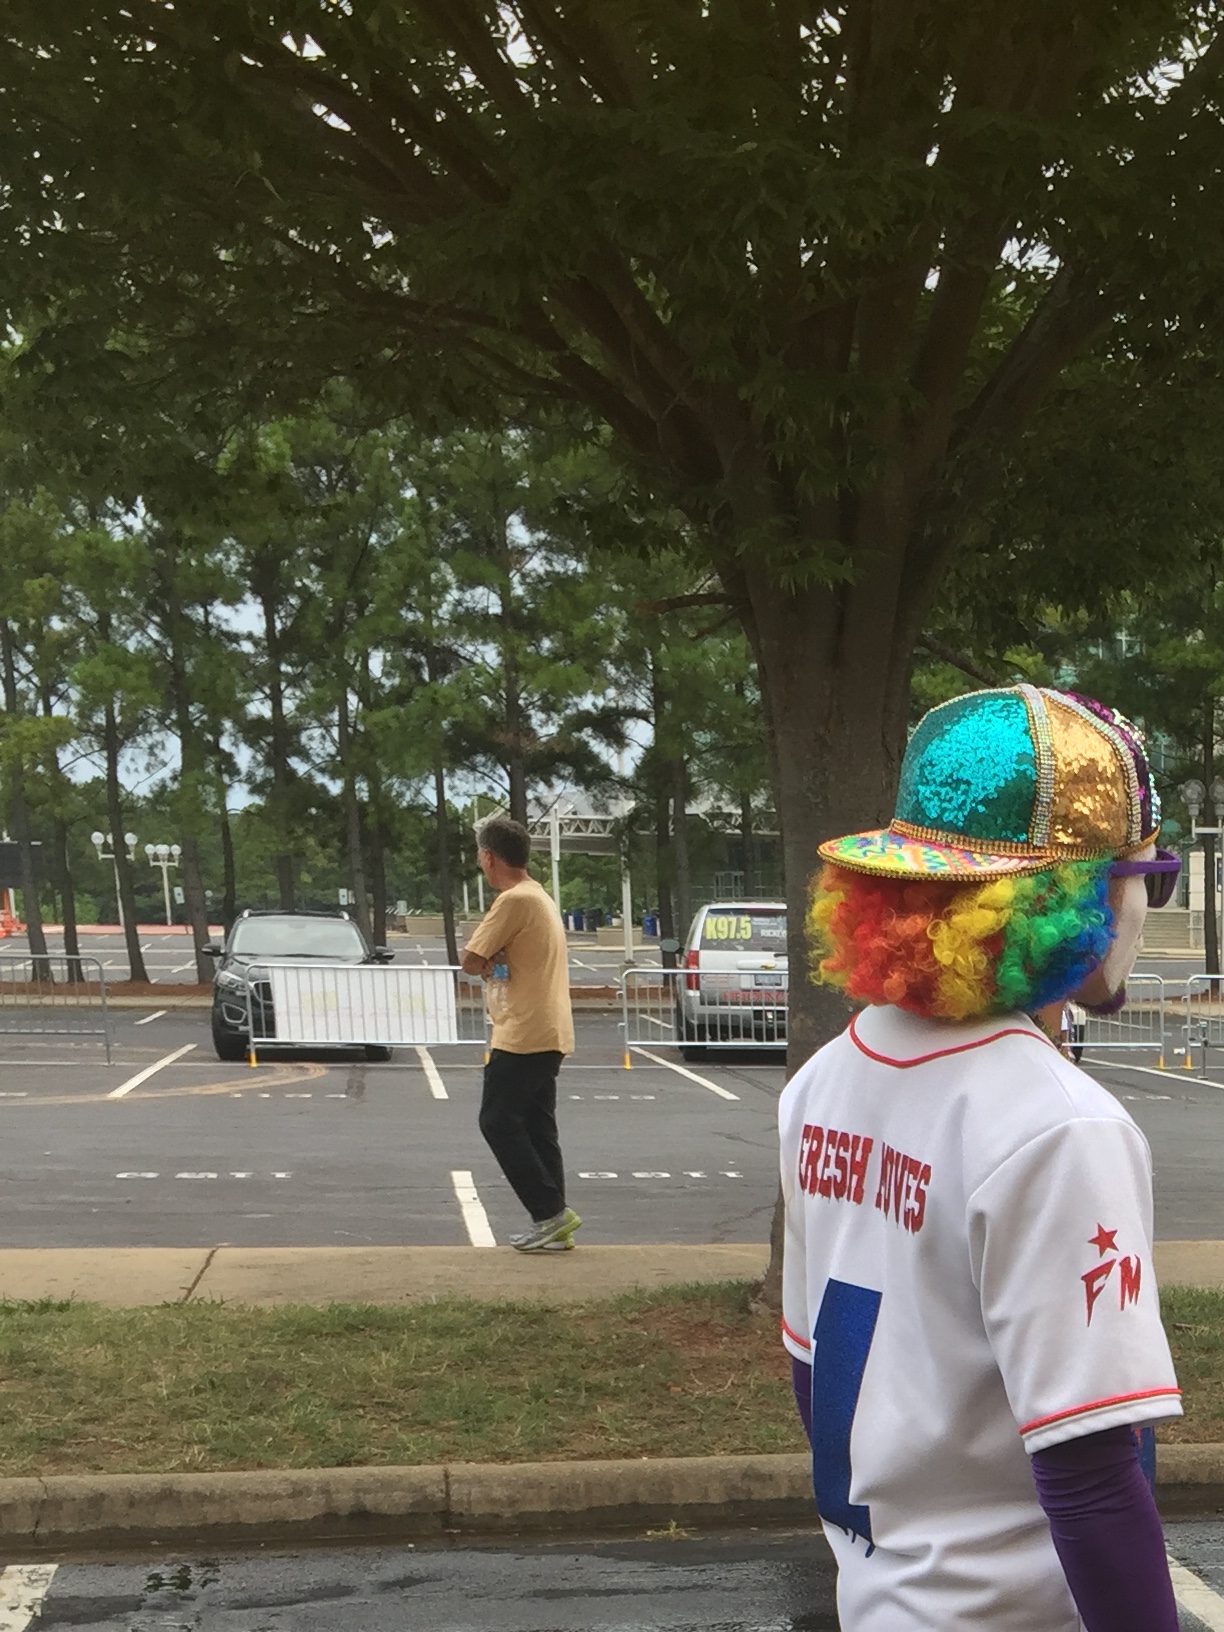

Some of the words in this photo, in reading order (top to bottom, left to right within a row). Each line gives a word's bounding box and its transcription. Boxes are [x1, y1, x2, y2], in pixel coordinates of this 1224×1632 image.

[706, 917, 752, 939] K97.5
[799, 1124, 873, 1205] FRESH
[1081, 1255, 1142, 1327] FM
